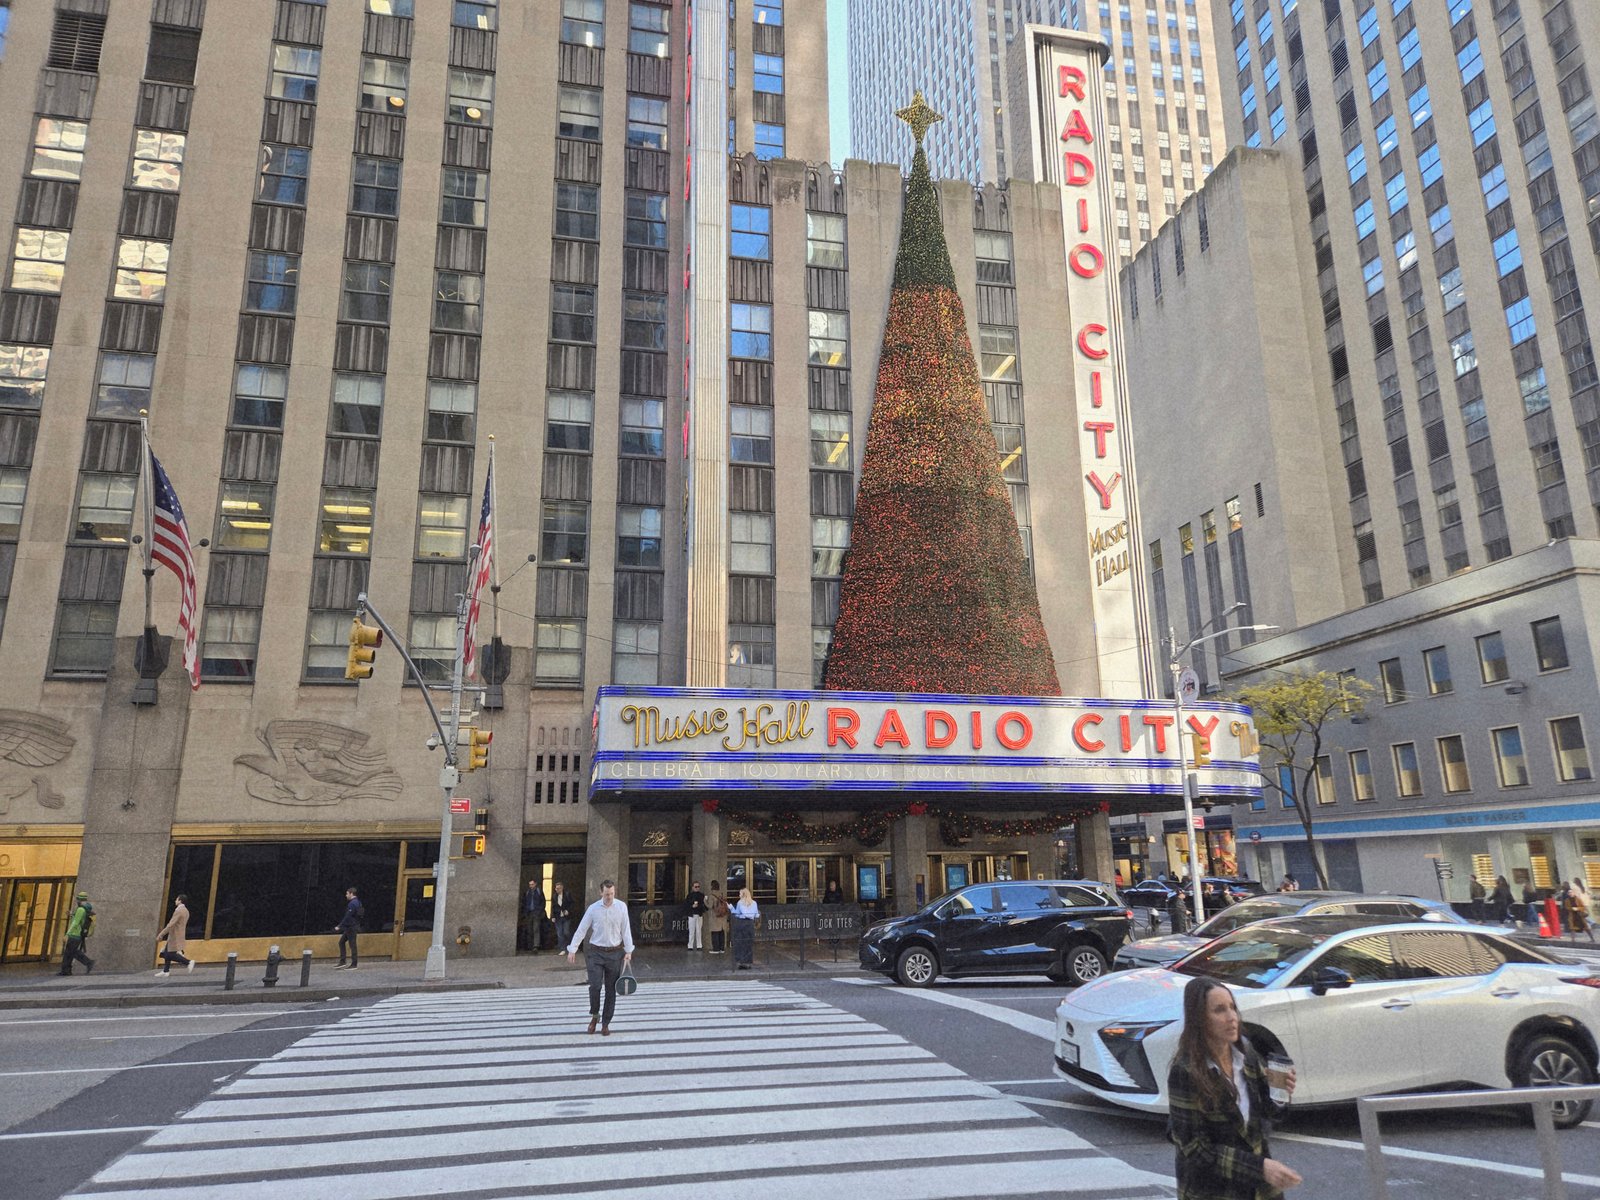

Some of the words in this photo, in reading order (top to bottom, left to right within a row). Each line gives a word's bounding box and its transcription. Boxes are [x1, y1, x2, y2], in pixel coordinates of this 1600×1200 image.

[1058, 65, 1104, 278] RADIO
[1077, 323, 1122, 510] CITY
[611, 762, 726, 778] CELEBRATE
[743, 763, 778, 778] 100
[792, 763, 853, 779] YEARS
[866, 764, 890, 779] OF
[722, 701, 814, 751] Hall
[827, 707, 1033, 750] RADIO
[1073, 713, 1220, 753] CITY
